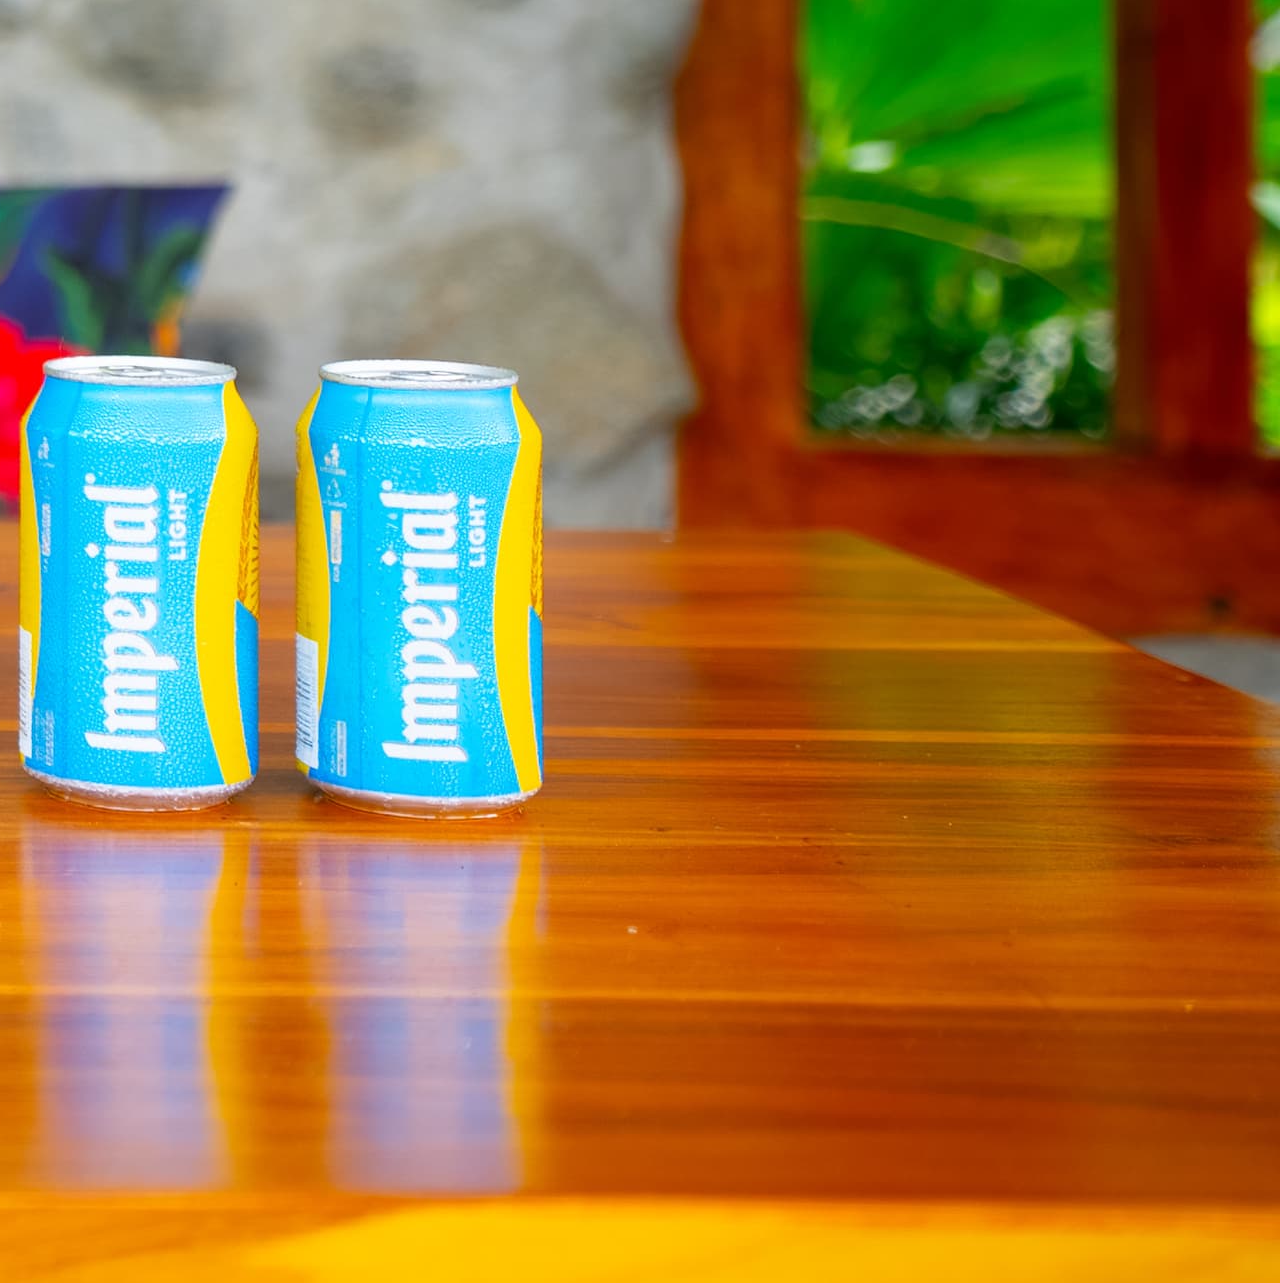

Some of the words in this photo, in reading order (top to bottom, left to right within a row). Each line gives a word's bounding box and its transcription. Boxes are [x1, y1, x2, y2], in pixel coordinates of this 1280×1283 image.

[168, 490, 188, 561] LIGHT
[468, 495, 487, 568] LIGHT
[83, 483, 179, 753] Imperial
[379, 491, 478, 762] Imperial
